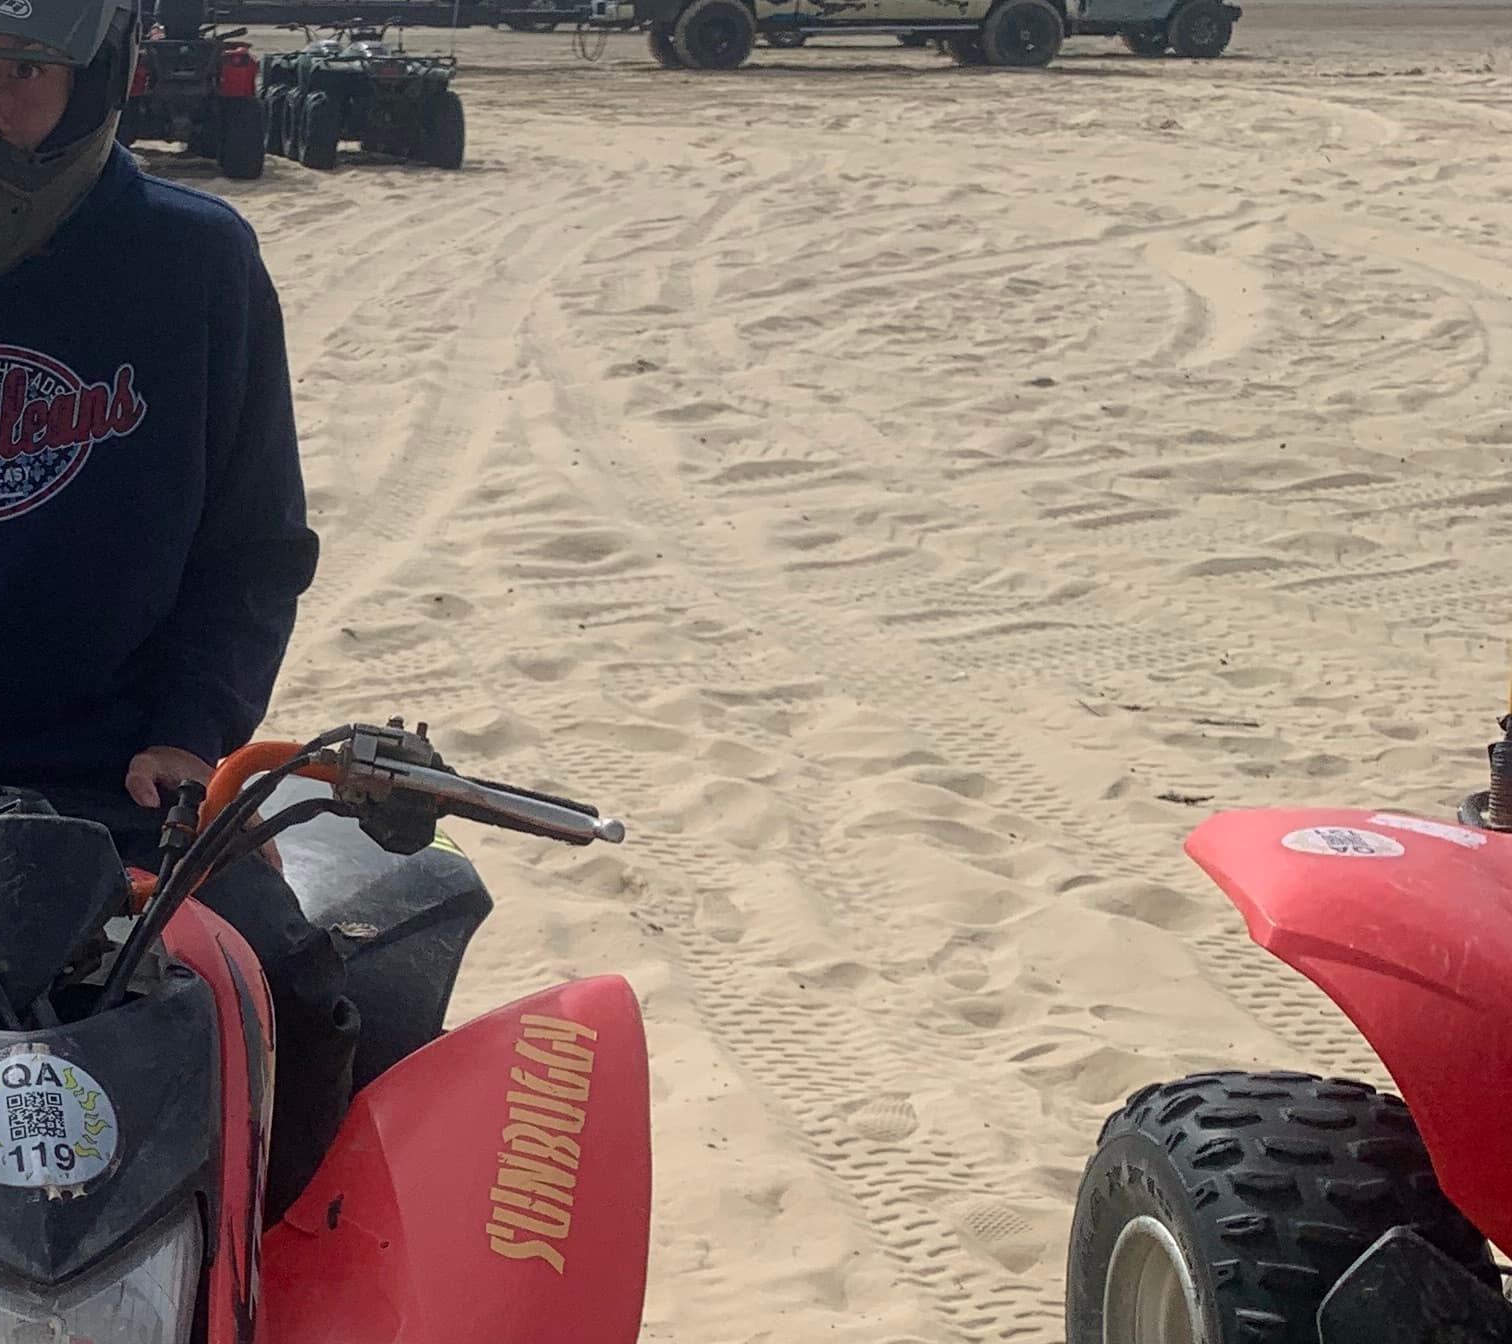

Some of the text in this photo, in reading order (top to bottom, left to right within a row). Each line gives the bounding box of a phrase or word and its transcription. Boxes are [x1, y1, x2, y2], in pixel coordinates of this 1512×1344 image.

[1, 1062, 63, 1089] QA
[8, 1141, 77, 1173] 119
[485, 1013, 600, 1275] SUNBUGGY
